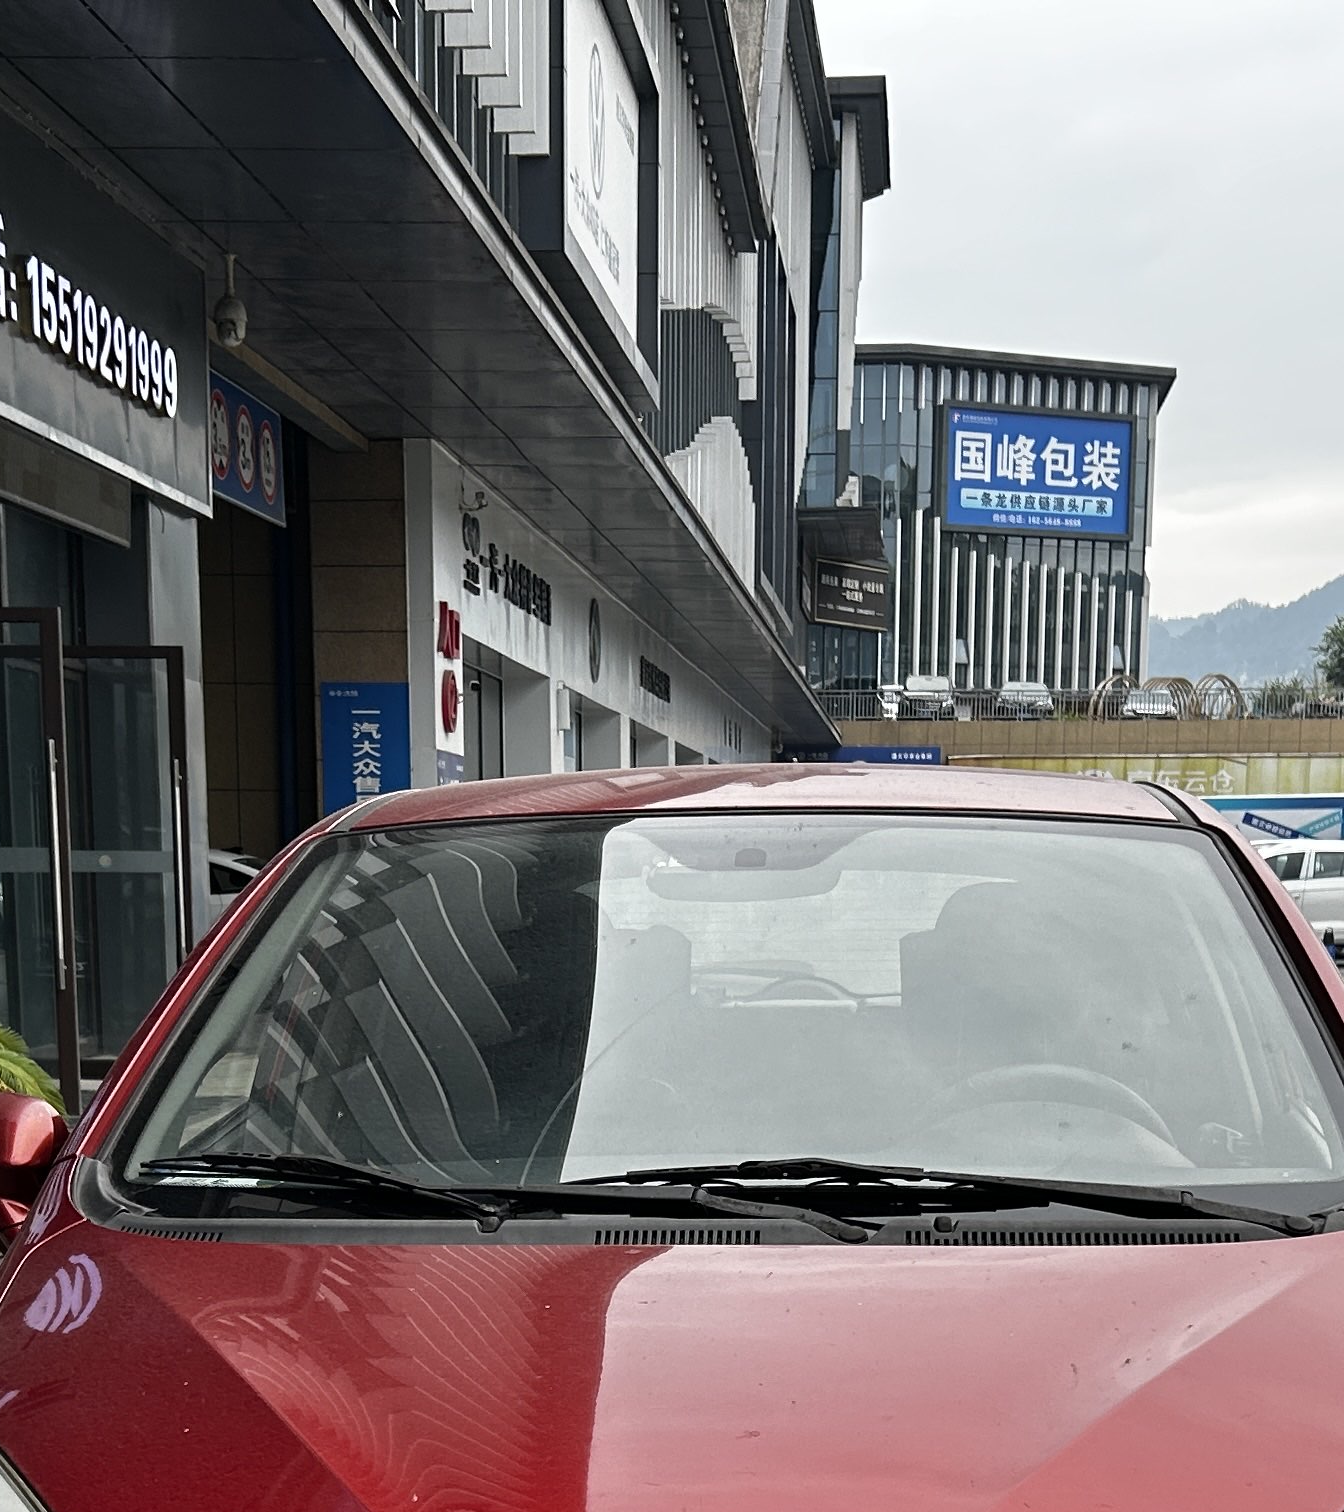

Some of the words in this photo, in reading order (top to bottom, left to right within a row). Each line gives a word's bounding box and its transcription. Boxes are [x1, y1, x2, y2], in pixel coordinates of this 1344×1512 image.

[954, 430, 1121, 492] 国峰包装
[965, 492, 1109, 515] 一条龙供应链源头厂家
